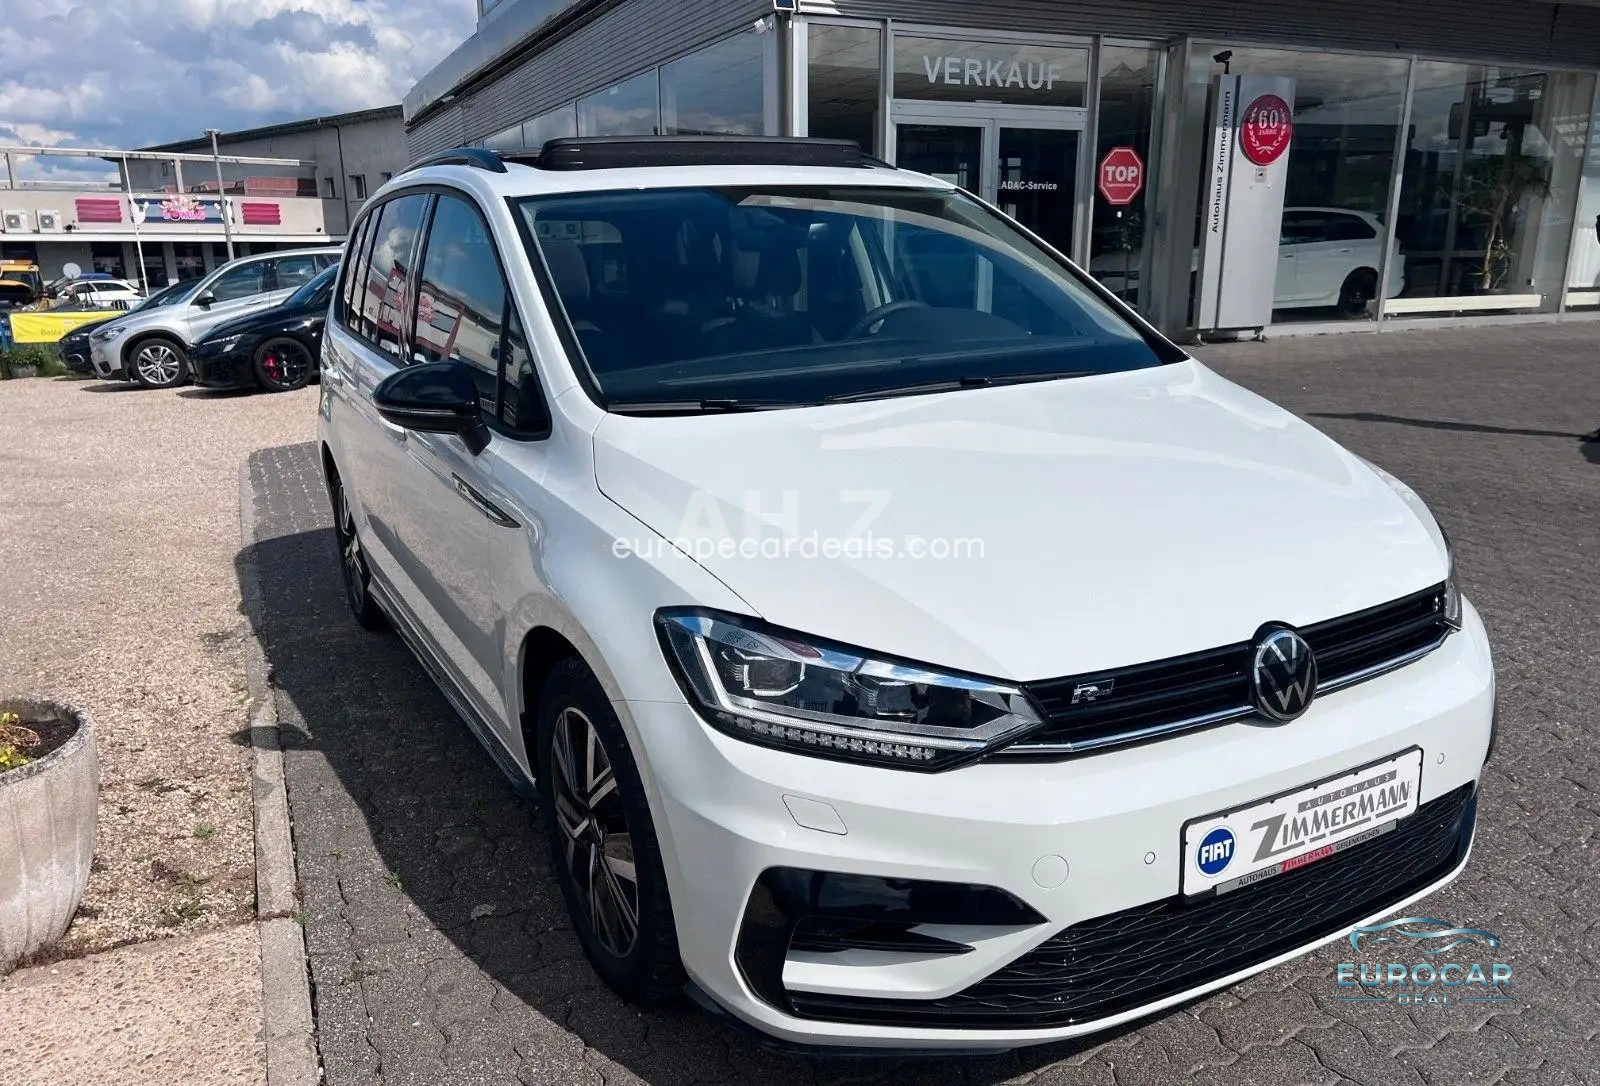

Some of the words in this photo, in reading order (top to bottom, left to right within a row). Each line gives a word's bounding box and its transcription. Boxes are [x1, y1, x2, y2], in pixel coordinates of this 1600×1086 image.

[923, 55, 1061, 91] VERKAUF
[1216, 91, 1231, 173] Zimmermann
[1258, 109, 1279, 129] 60
[1001, 181, 1058, 190] ADAC-Service
[1105, 165, 1138, 182] TOP
[1211, 176, 1223, 234] Autohaus
[1306, 773, 1390, 809] AUTOHAUS
[1250, 780, 1410, 863] ZIMMERMANN
[1200, 838, 1232, 865] FIAT
[1238, 866, 1277, 887] AUTOHAUS
